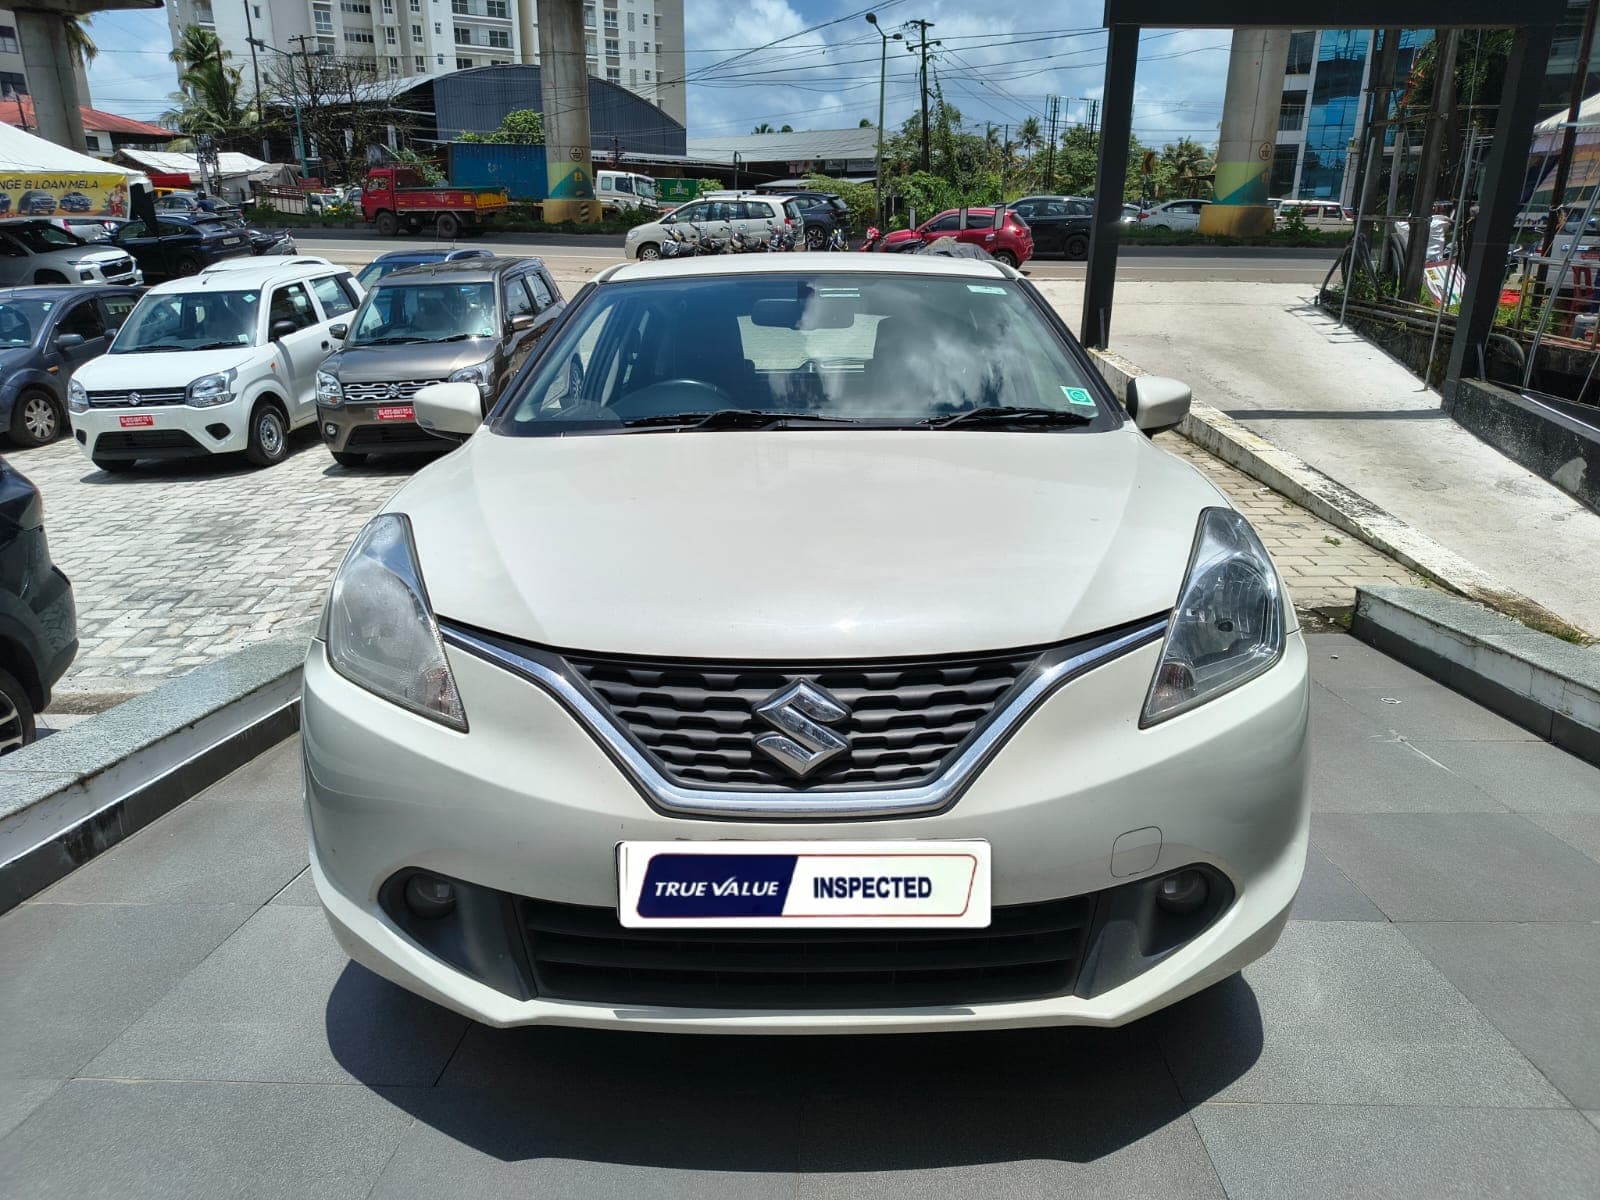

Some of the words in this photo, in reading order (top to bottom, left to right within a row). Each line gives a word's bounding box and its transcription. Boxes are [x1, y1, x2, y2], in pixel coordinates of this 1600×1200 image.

[34, 180, 67, 190] LOAN
[67, 180, 98, 189] MELA
[655, 881, 708, 897] TRUE
[711, 876, 779, 897] VALUE
[813, 876, 932, 899] INSPECTED
